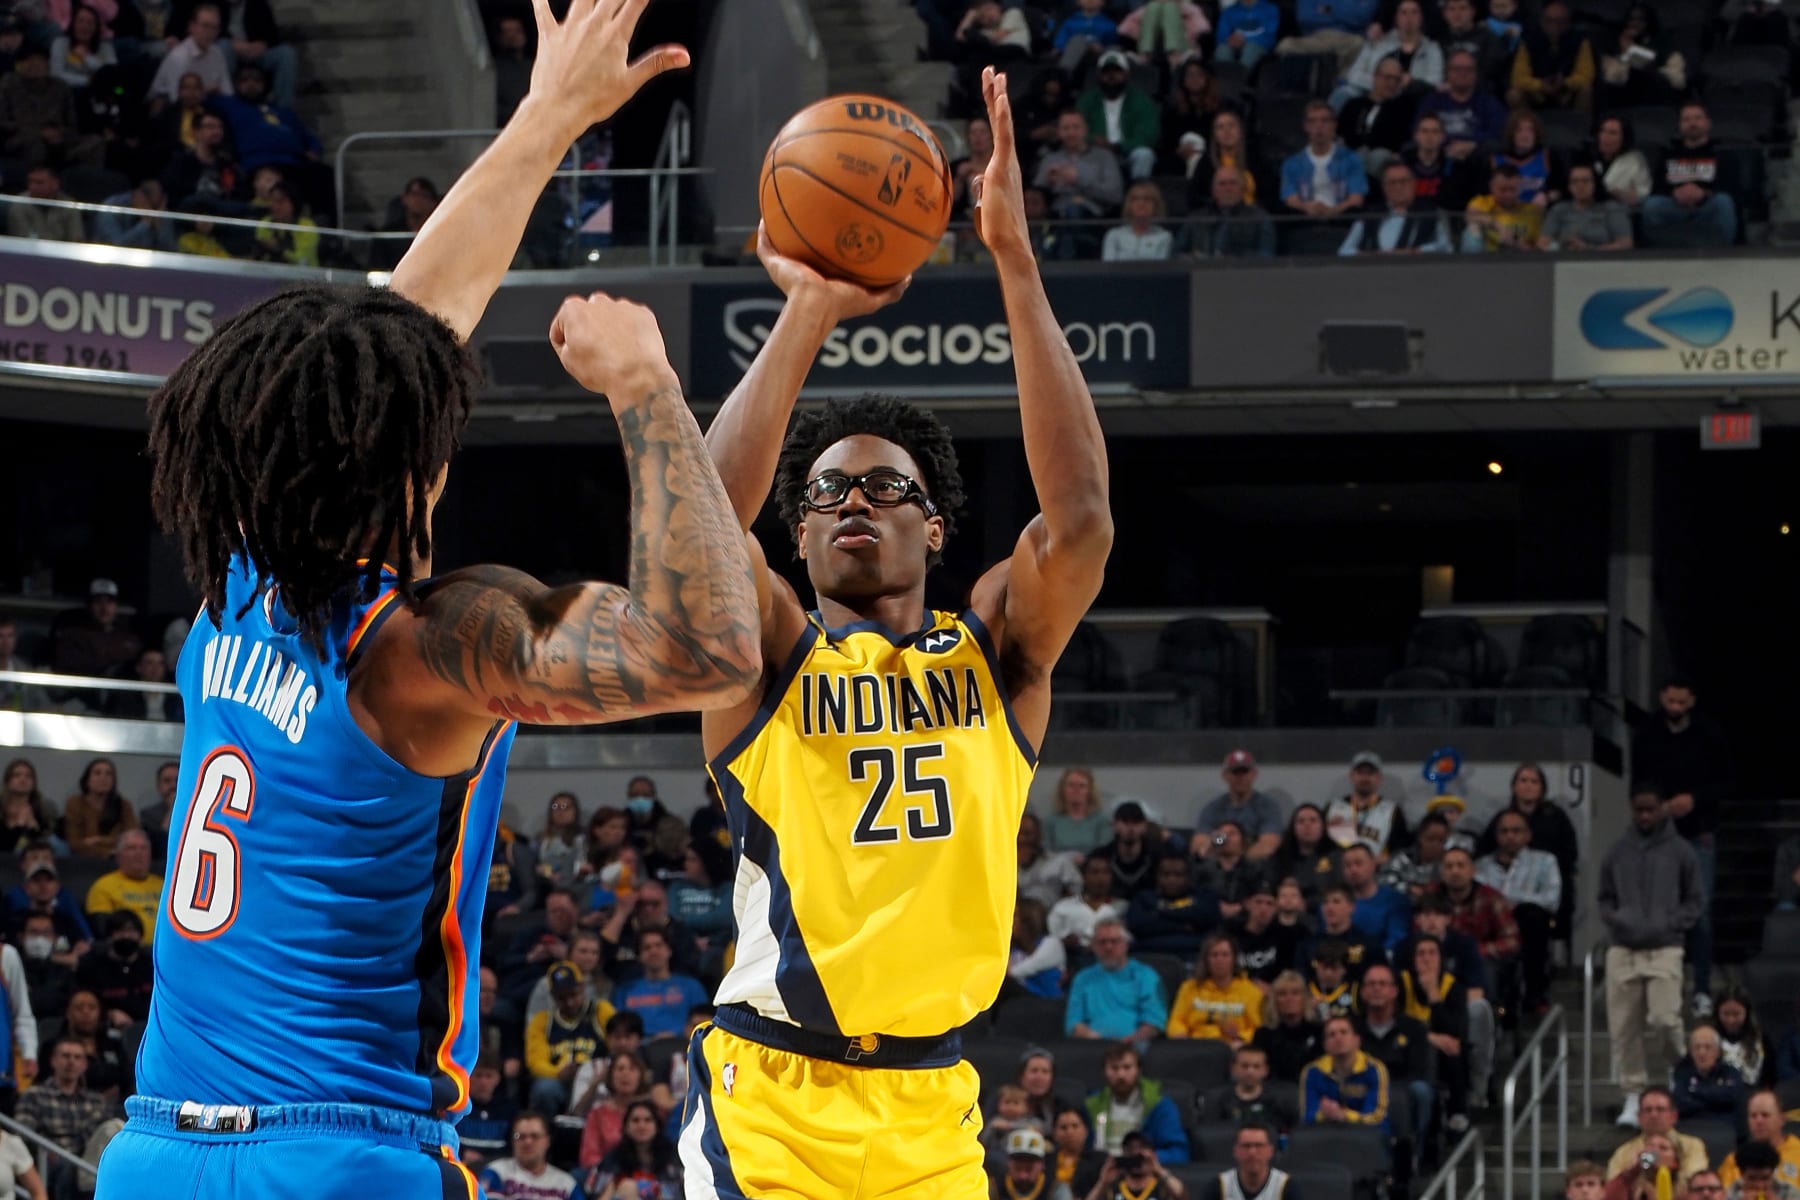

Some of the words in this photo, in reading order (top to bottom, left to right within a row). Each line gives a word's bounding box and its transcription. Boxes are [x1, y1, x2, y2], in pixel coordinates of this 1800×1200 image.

[4, 282, 215, 345] DONUTS
[65, 346, 130, 371] 1961
[1680, 345, 1788, 371] water
[1711, 413, 1752, 443] EXIT
[203, 634, 318, 744] WILLIAMS
[801, 667, 986, 736] INDIANA
[848, 741, 954, 846] 25
[1569, 764, 1585, 809] 9
[168, 744, 257, 941] 6
